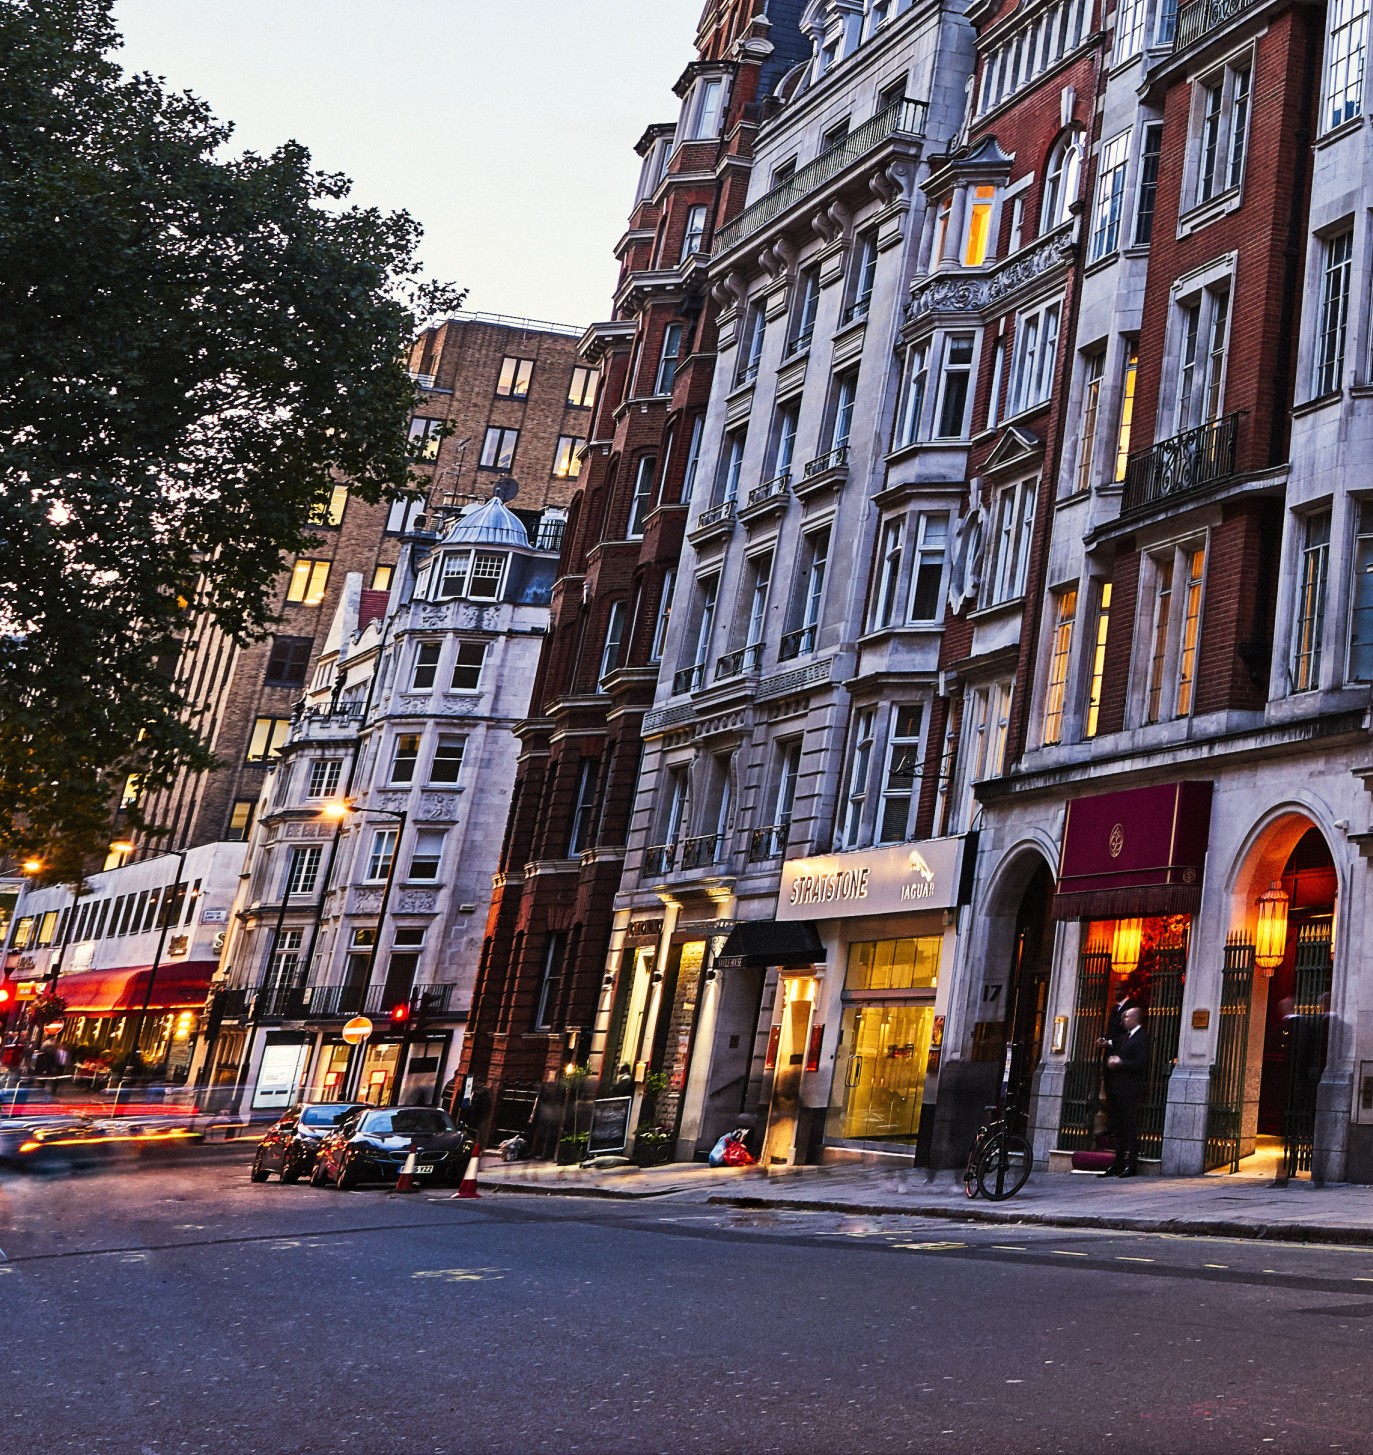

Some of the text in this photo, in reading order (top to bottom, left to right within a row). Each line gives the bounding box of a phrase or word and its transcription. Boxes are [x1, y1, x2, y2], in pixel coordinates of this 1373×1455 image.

[790, 867, 934, 906] STRATSTONE JAGUAR
[982, 984, 1003, 1002] 17
